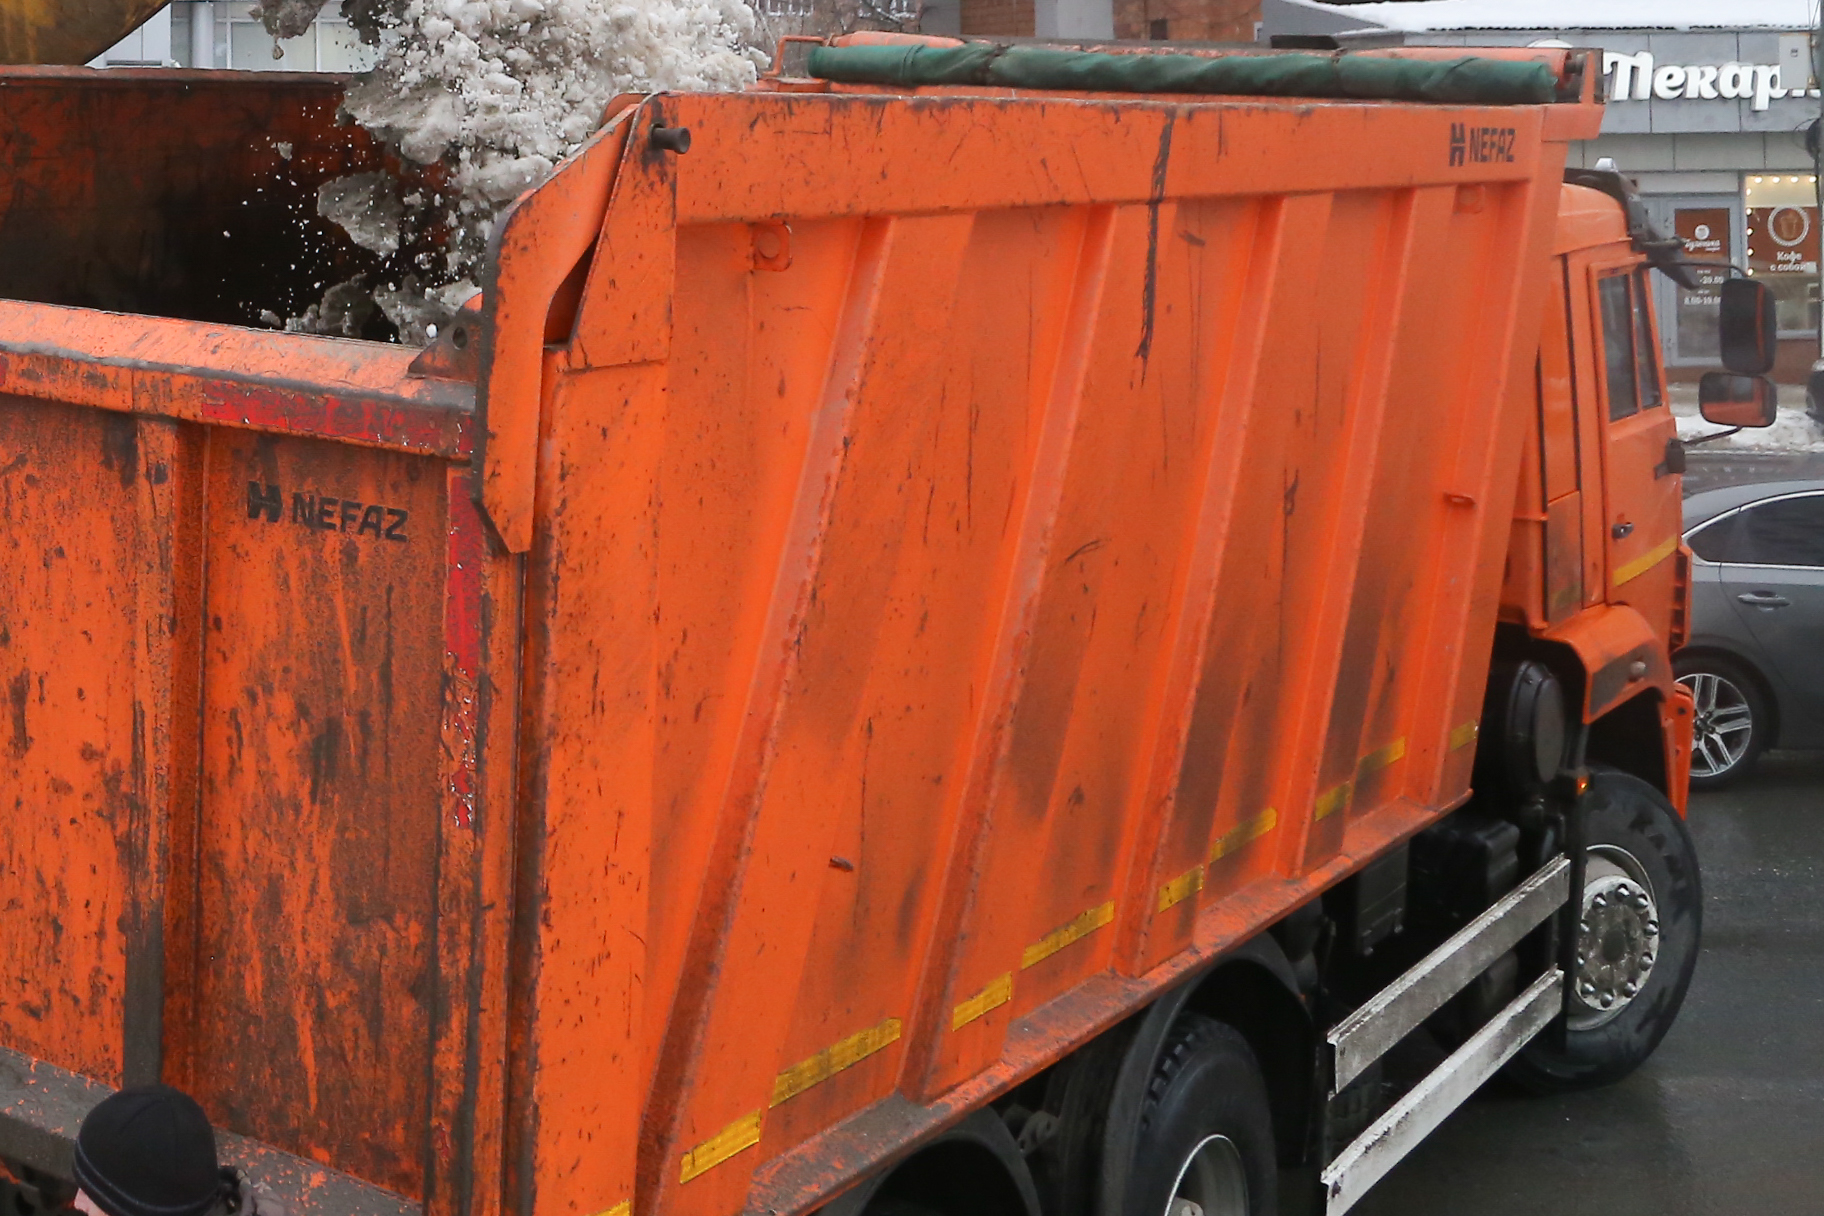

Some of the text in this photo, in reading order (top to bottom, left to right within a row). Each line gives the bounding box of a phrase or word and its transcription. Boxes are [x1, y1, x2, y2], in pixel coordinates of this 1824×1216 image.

[1603, 50, 1821, 111] Пекар
[1470, 127, 1516, 163] NEFAZ
[292, 492, 409, 543] NEFAZ
